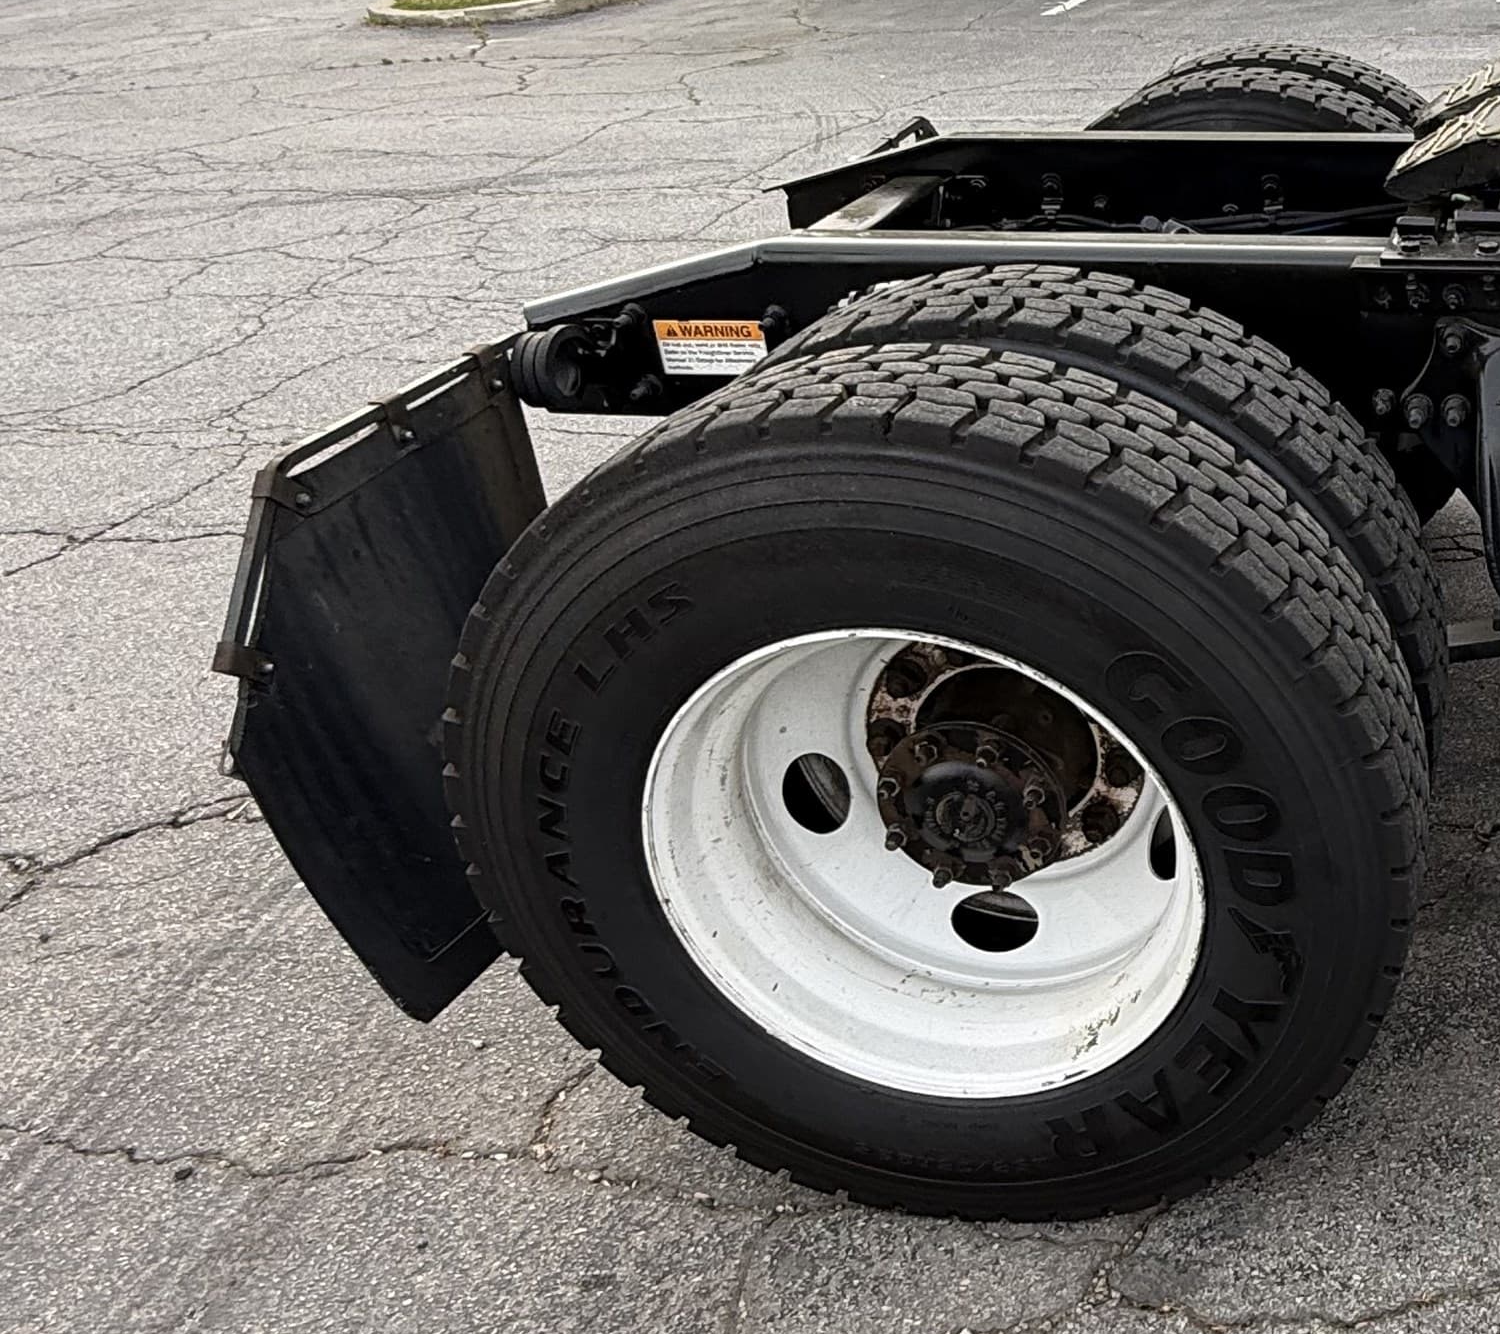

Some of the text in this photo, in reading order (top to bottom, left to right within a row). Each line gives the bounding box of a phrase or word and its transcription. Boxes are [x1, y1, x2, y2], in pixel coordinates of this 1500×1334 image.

[678, 325, 752, 338] WARNING
[572, 581, 696, 694] LHS
[537, 706, 736, 1081] ENDURANCE
[1042, 650, 1305, 1160] GOODYEAR
